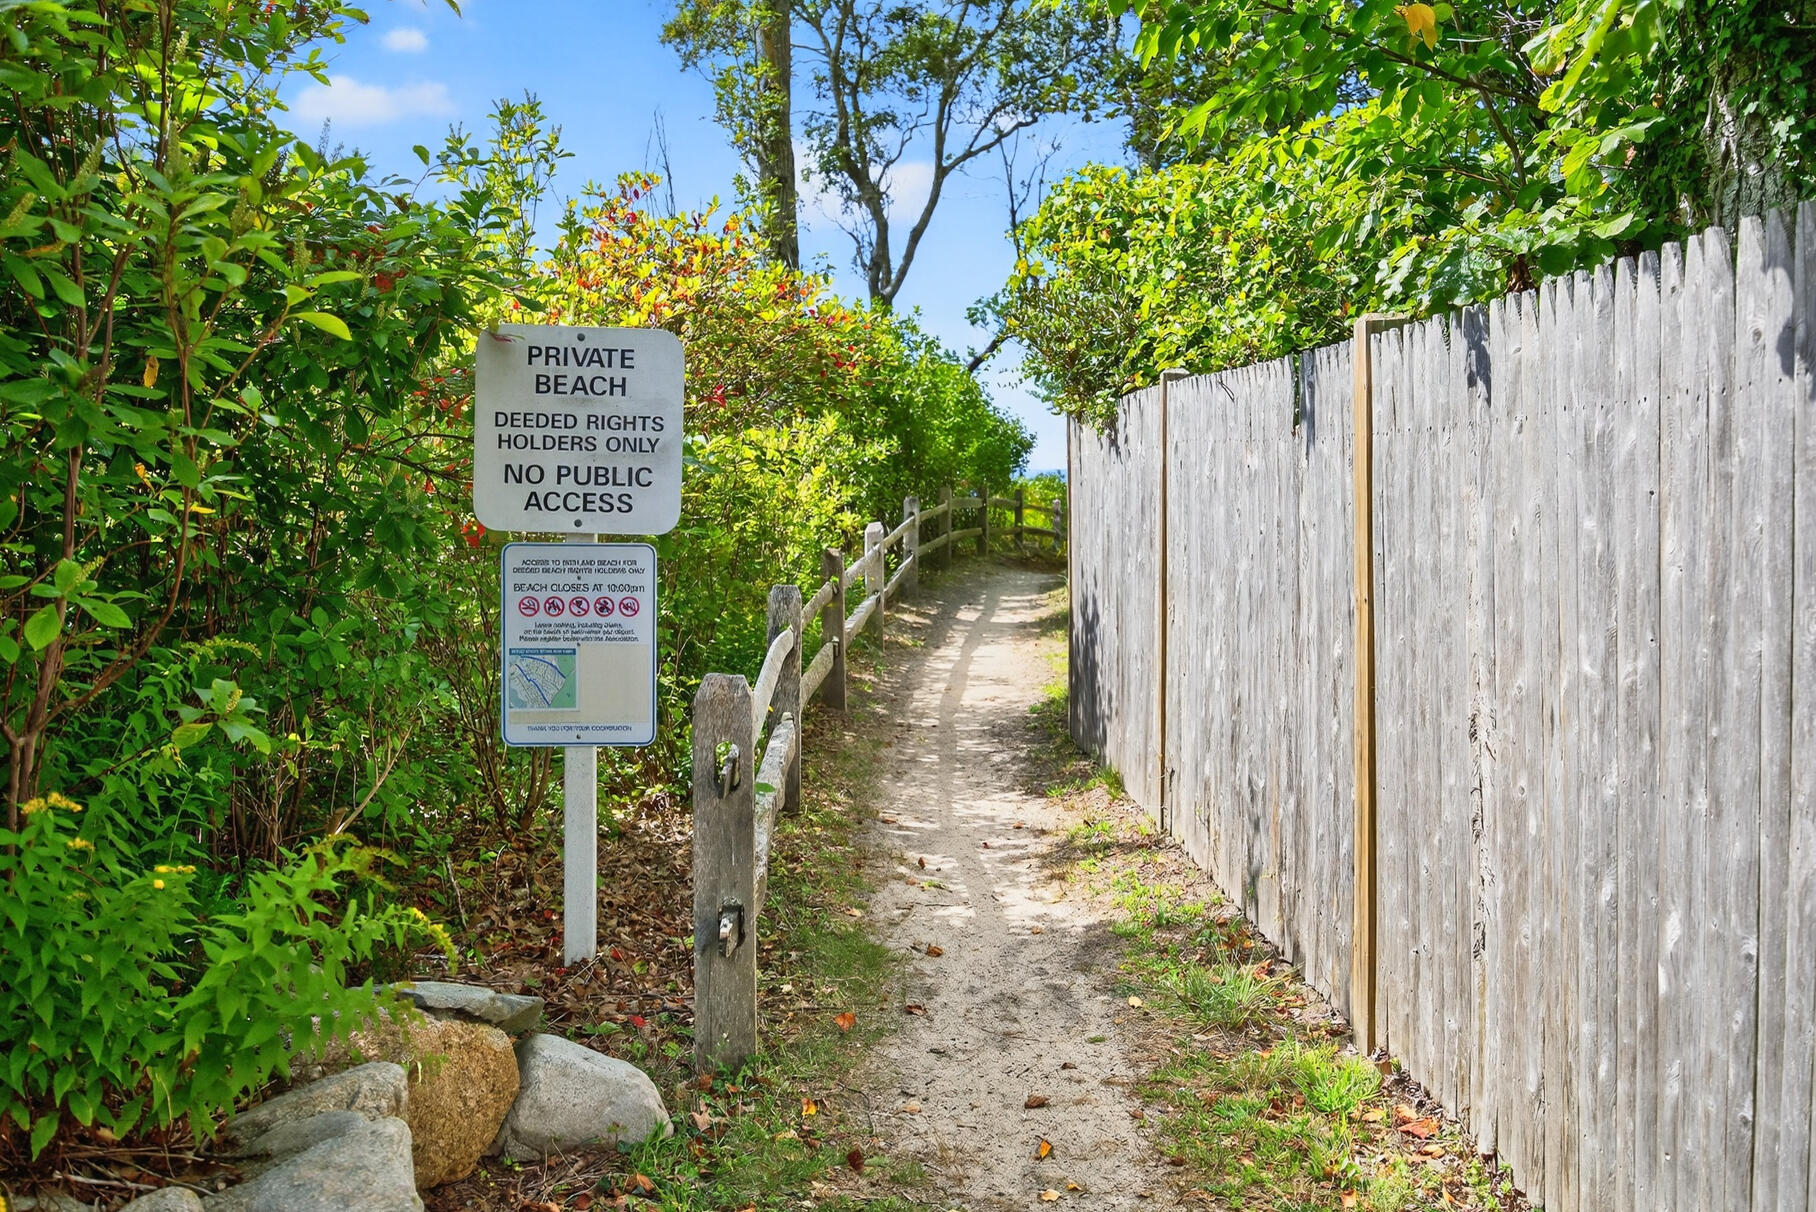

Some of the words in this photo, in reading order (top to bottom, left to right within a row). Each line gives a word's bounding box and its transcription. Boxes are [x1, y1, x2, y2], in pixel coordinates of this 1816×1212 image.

[528, 346, 635, 369] PRIVATE
[535, 374, 626, 396] BEACH
[495, 412, 577, 429] DEEDED
[587, 416, 664, 432] RIGHTS
[498, 434, 596, 451] HOLDERS
[606, 437, 660, 453] ONLY
[504, 464, 544, 484] NO
[557, 465, 653, 487] PUBLIC
[524, 492, 633, 513] ACCESS
[514, 584, 547, 592] BEACH
[550, 584, 589, 592] CLOSES
[592, 584, 603, 592] AT
[607, 584, 645, 593] 10:00pm
